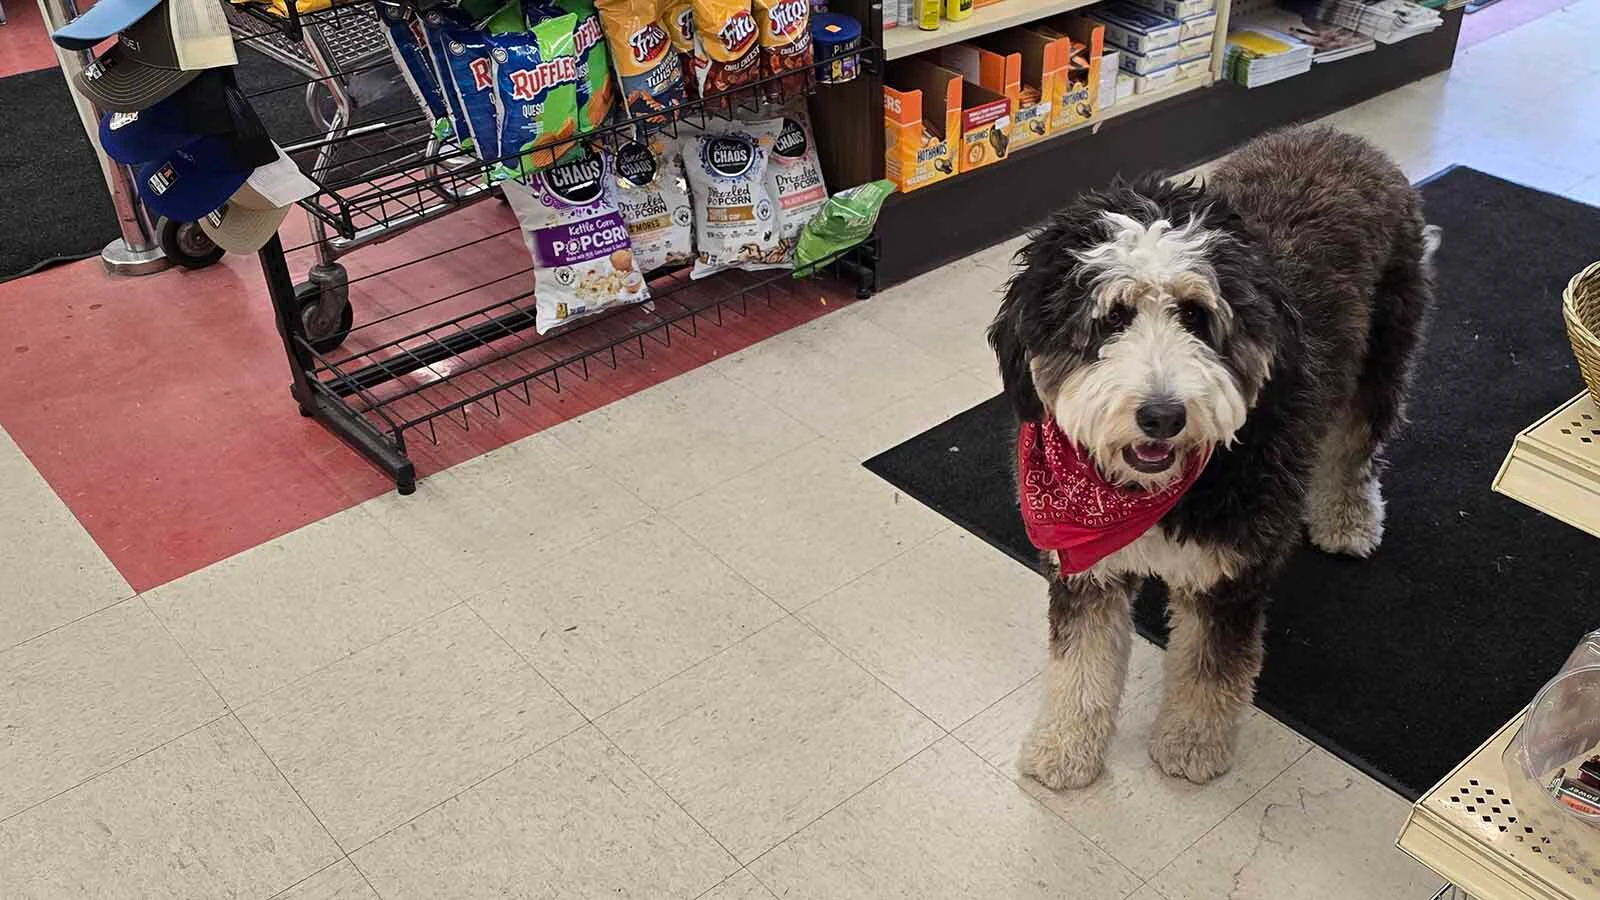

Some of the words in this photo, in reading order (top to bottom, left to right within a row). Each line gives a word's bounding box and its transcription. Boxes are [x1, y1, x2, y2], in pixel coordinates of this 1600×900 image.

[768, 0, 807, 33] Fritos
[629, 24, 667, 61] Frito
[719, 16, 756, 49] Frito
[510, 57, 577, 100] RUFFLES
[522, 103, 544, 118] QUESO
[775, 131, 804, 151] CHAOS
[713, 150, 748, 163] CHAOS
[551, 160, 600, 188] CHAOS
[621, 159, 653, 177] CHAOS
[707, 196, 752, 206] POPCORN
[568, 221, 595, 237] Kettle
[595, 218, 616, 230] Corn
[552, 225, 629, 257] POPCORN
[1568, 786, 1600, 801] power
